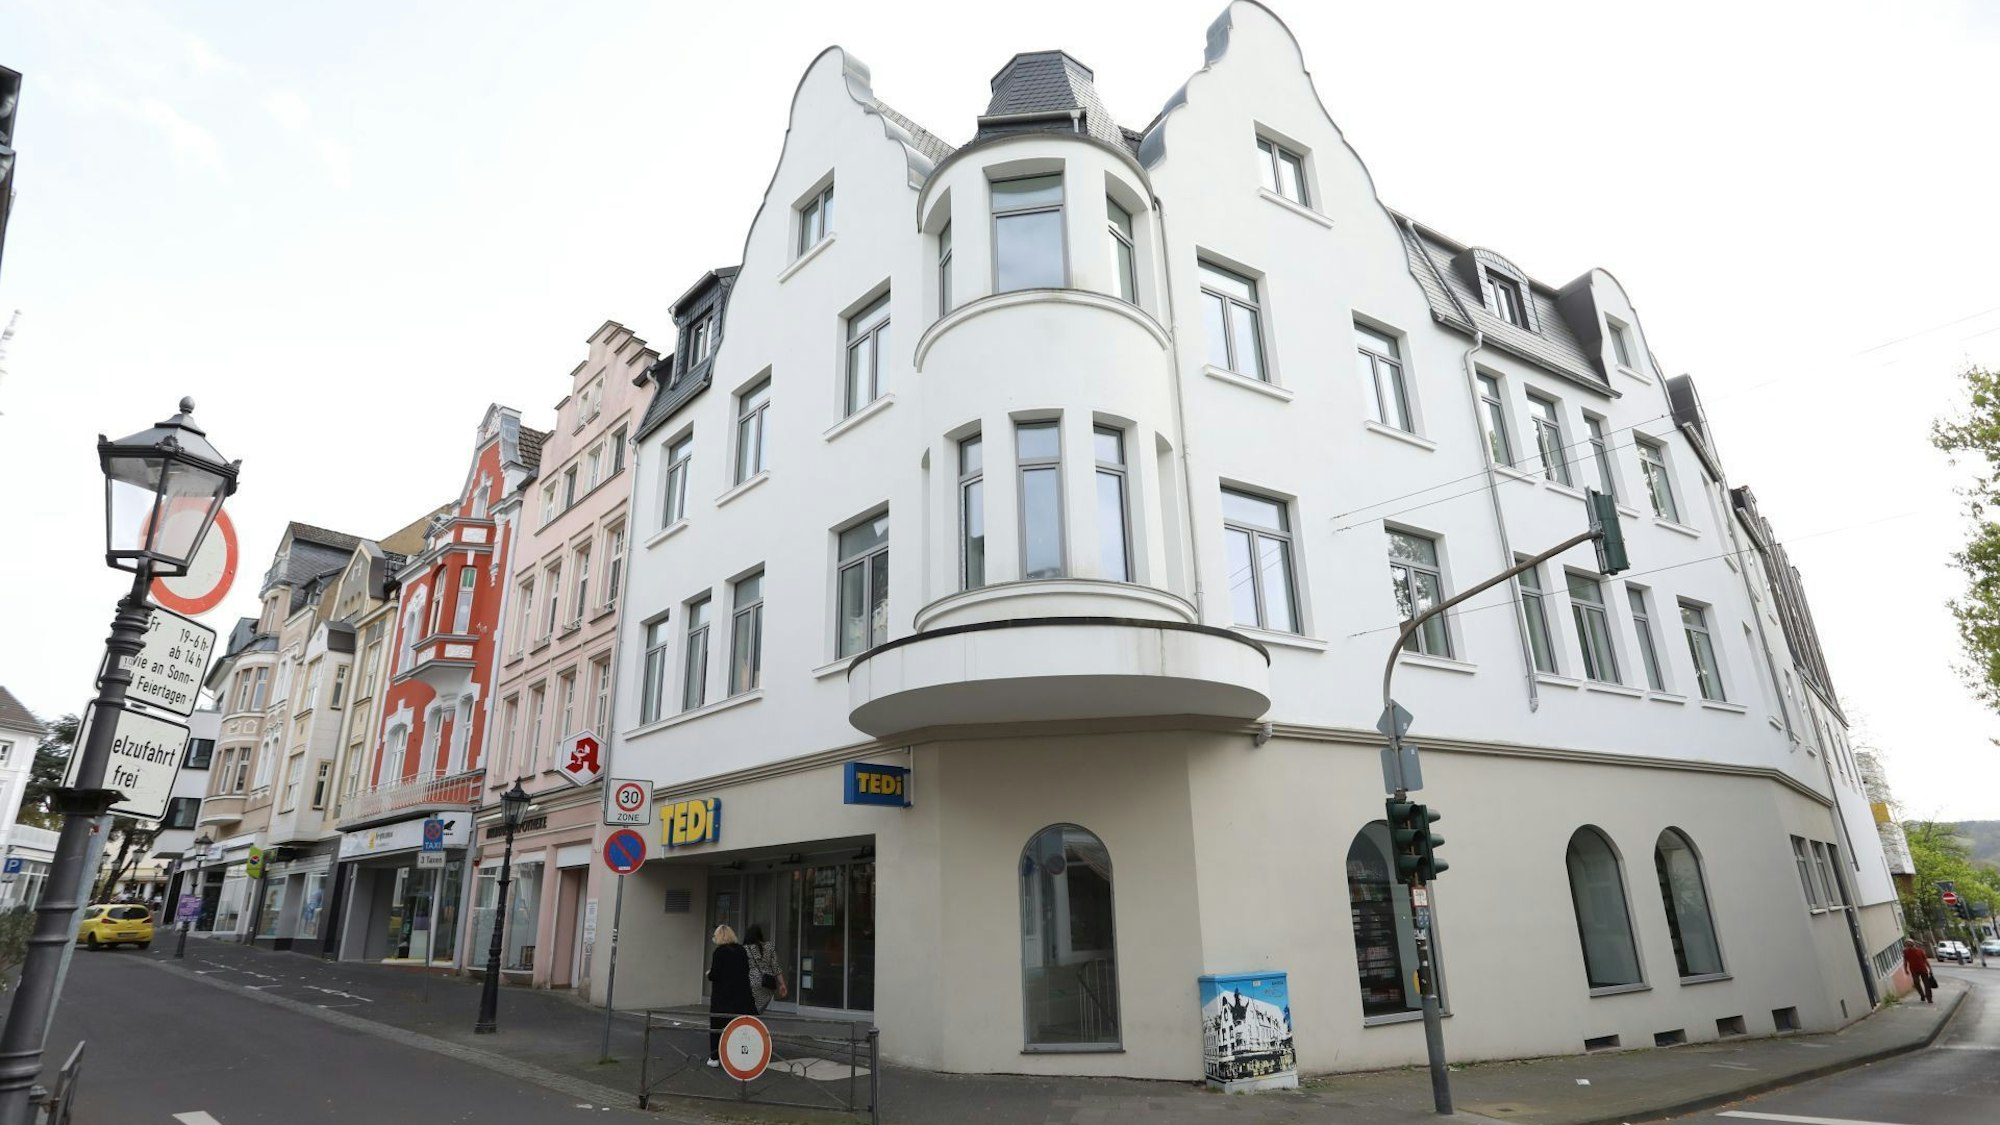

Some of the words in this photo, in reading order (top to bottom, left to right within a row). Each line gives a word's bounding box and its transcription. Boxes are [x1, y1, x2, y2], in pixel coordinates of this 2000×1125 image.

[180, 628, 200, 648] 19-6
[169, 645, 181, 660] ab
[185, 649, 195, 665] 14
[195, 653, 202, 668] h
[151, 662, 164, 675] an
[167, 664, 194, 685] Sonn-
[136, 675, 187, 705] Feiertagen
[113, 735, 176, 768] elzufahrt
[113, 764, 140, 790] frei
[856, 772, 902, 796] TEDi
[621, 790, 639, 804] 30
[617, 813, 640, 822] ZONE
[659, 798, 716, 847] TEDi
[424, 842, 441, 850] TAXI
[6, 859, 20, 871] P
